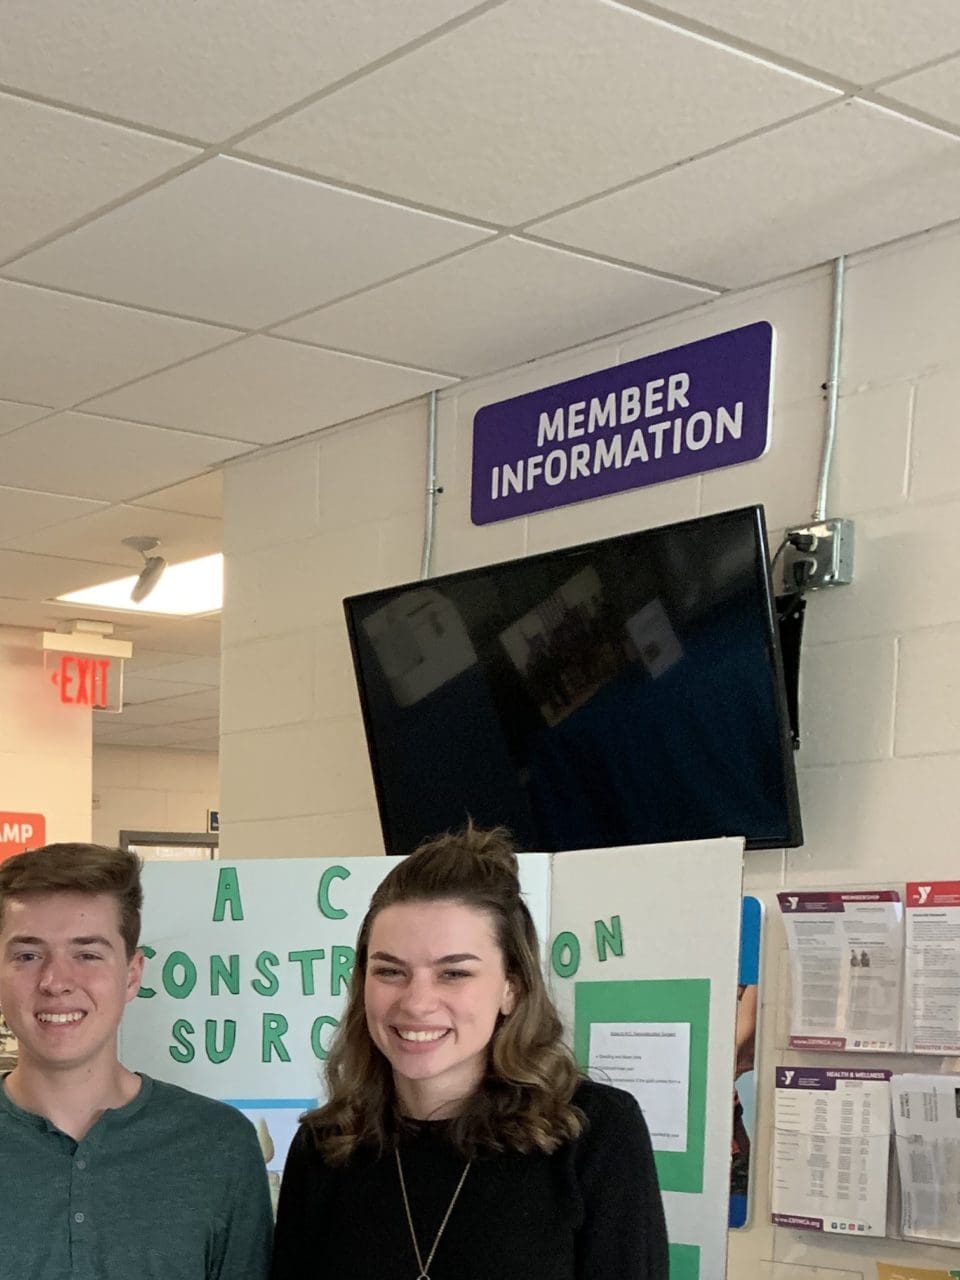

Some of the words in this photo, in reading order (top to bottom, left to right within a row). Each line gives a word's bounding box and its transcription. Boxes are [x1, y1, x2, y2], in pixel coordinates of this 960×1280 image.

[537, 372, 690, 447] MEMBER
[491, 401, 744, 500] INFORMATION
[61, 655, 111, 708] EXIT
